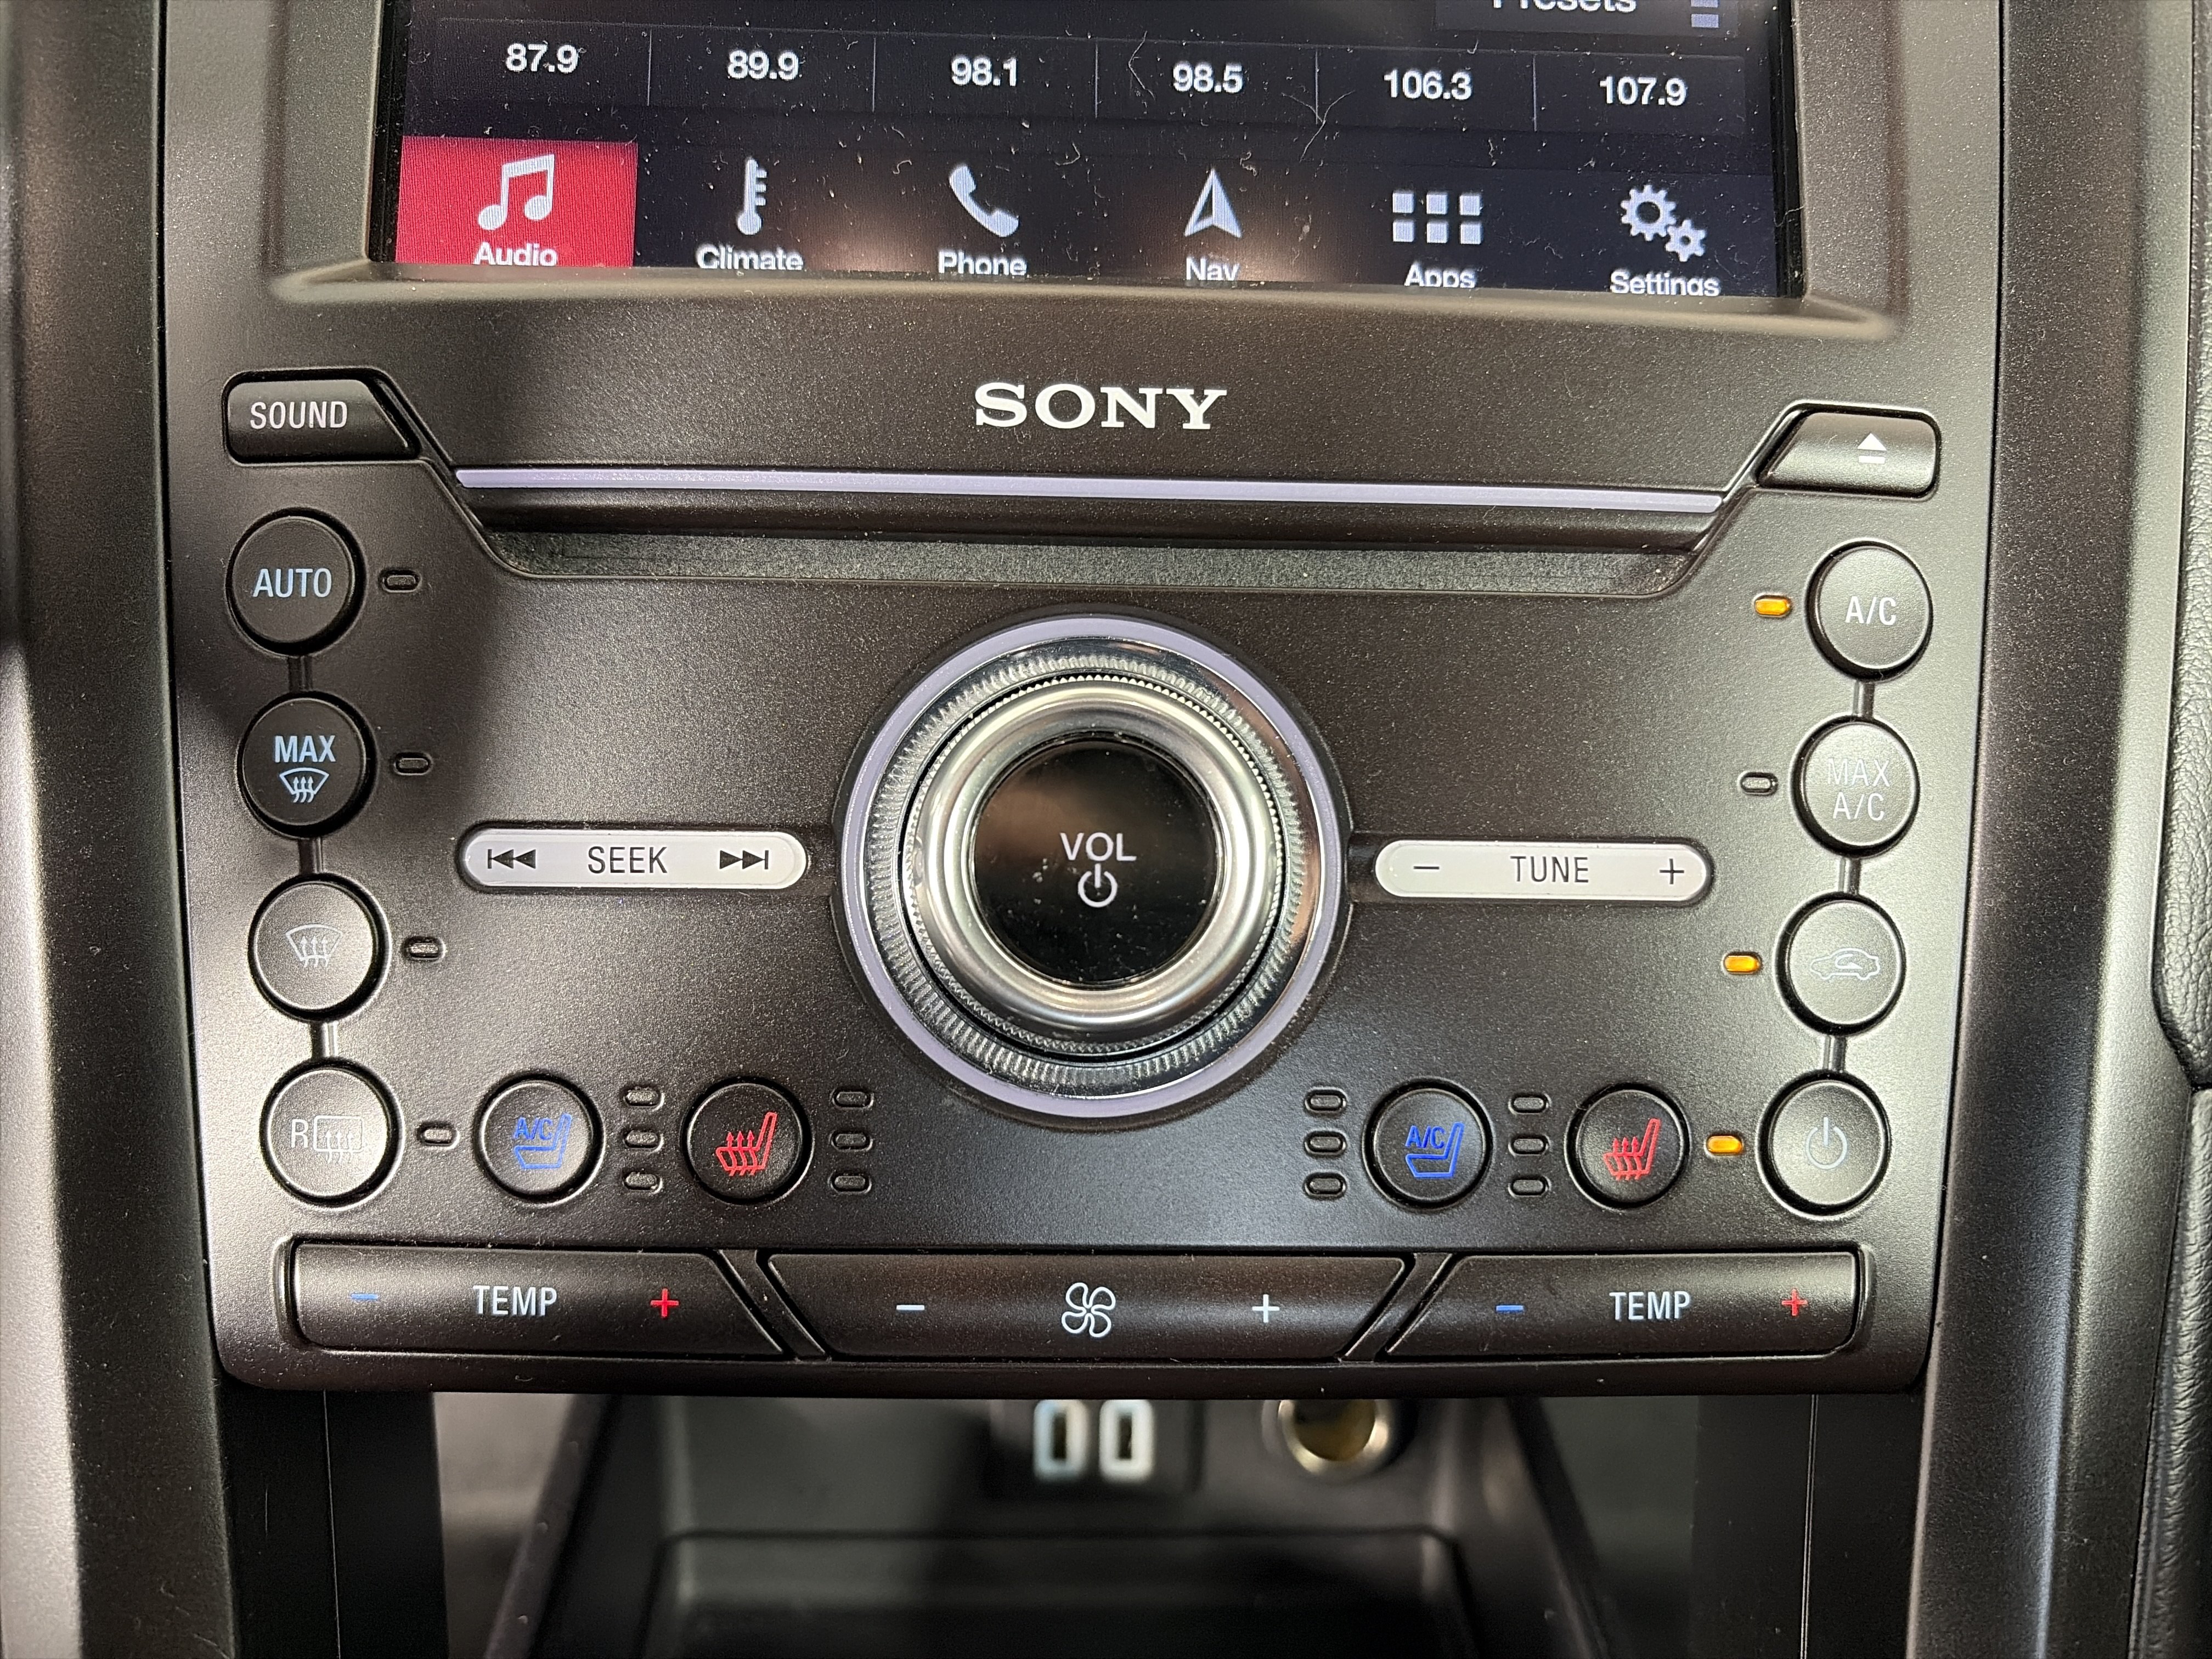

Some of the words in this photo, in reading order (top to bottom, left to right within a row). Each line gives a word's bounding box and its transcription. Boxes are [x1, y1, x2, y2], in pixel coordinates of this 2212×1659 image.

[506, 43, 578, 73] 87.9
[728, 50, 798, 81] 89.9
[952, 57, 1016, 86] 98.1
[1173, 63, 1242, 93] 98.5
[1384, 70, 1471, 100] 106.3
[1600, 76, 1688, 105] 107.9
[473, 241, 558, 267] Audio
[696, 245, 804, 270] Climate
[938, 250, 1026, 276] Phone
[1186, 255, 1239, 281] Nav
[250, 402, 347, 429] SOUND
[975, 382, 1227, 429] SONY
[253, 568, 331, 597] AUTO
[1844, 595, 1897, 625] A/C
[275, 736, 335, 762] MAX
[1827, 757, 1891, 787] MAX
[1832, 792, 1885, 821] A/C
[589, 847, 667, 873] SEEK
[1060, 833, 1136, 861] VOL
[1511, 856, 1588, 882] TUNE
[290, 1118, 309, 1149] R
[513, 1117, 553, 1142] A/C
[1405, 1125, 1445, 1150] A/C
[473, 1285, 557, 1316] TEMP
[1609, 1291, 1691, 1320] TEMP
